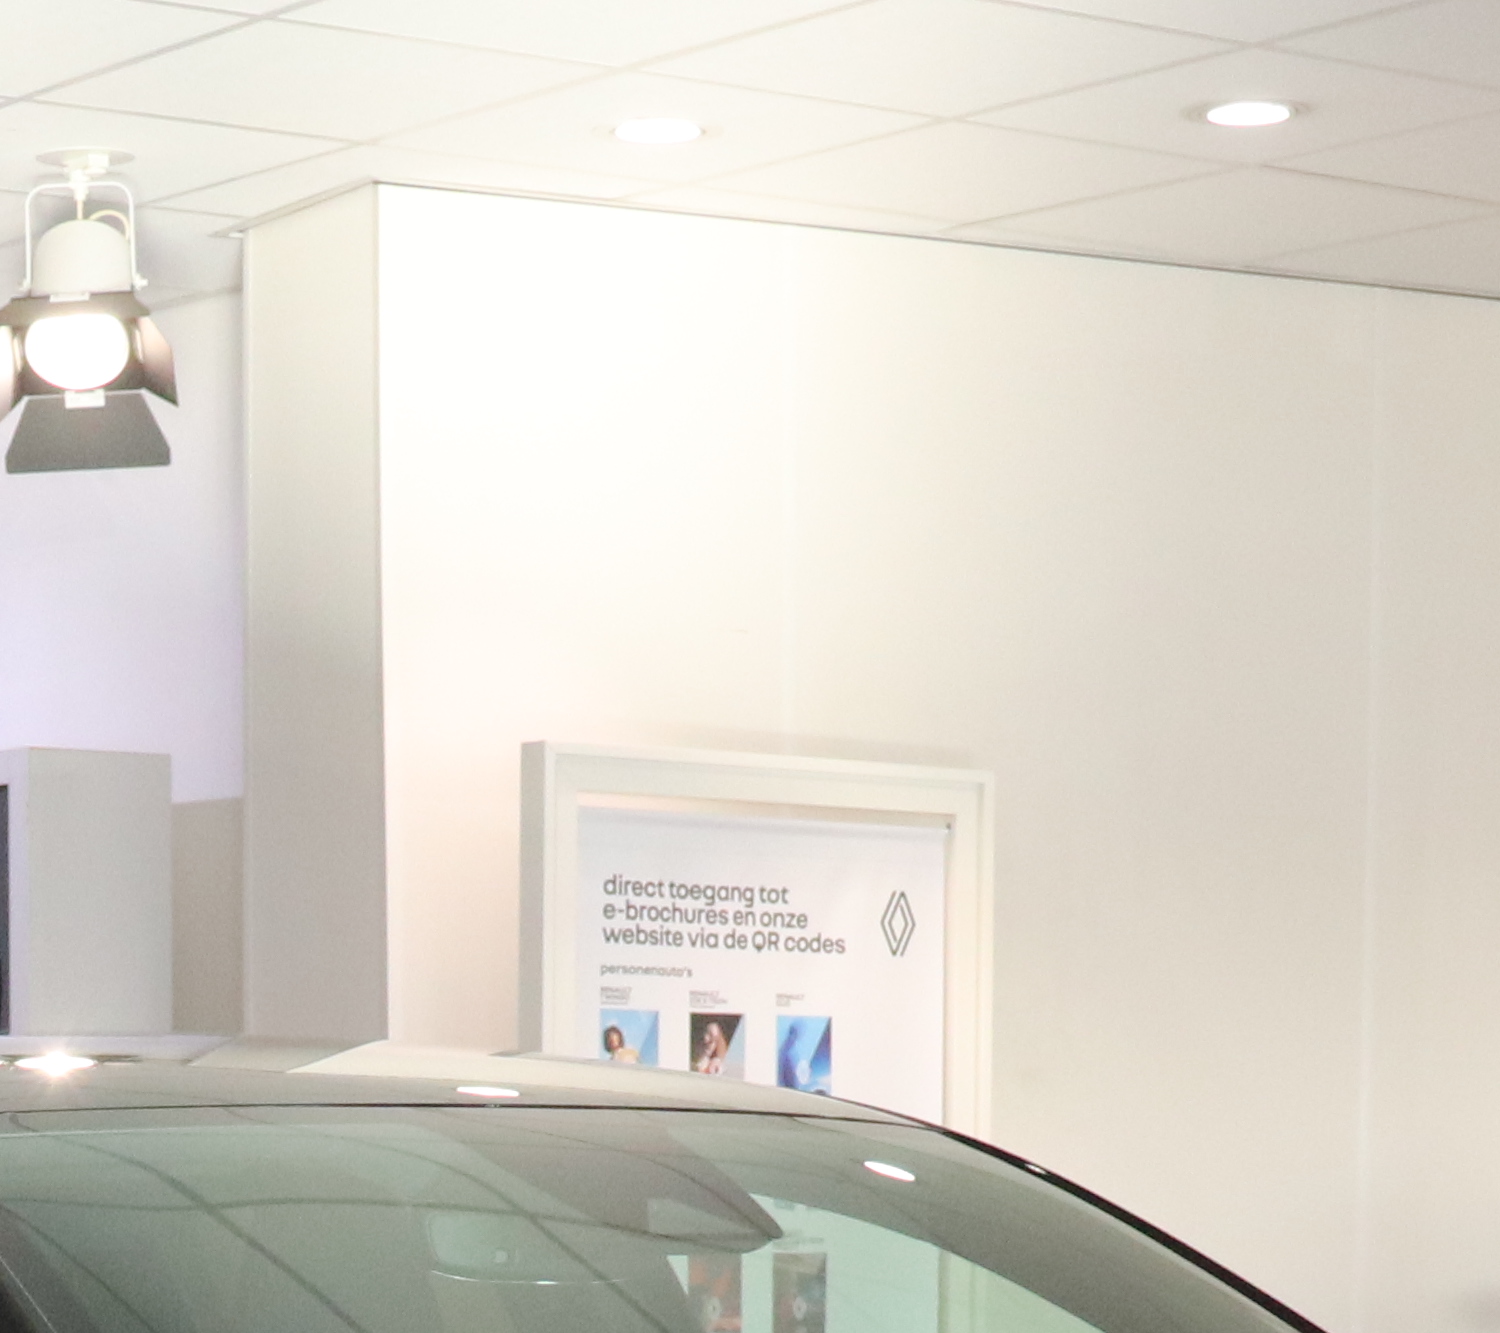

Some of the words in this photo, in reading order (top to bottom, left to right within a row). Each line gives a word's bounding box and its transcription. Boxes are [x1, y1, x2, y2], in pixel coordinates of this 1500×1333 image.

[603, 873, 665, 901] direct
[669, 880, 755, 908] toegang
[758, 884, 790, 905] tot
[603, 898, 729, 927] e-brochures
[732, 911, 757, 928] en
[759, 911, 808, 929] onze
[602, 922, 684, 948] website
[686, 927, 719, 949] via
[723, 928, 748, 951] de
[752, 931, 780, 953] QR
[783, 932, 846, 954] codes
[600, 963, 693, 979] personenauto's
